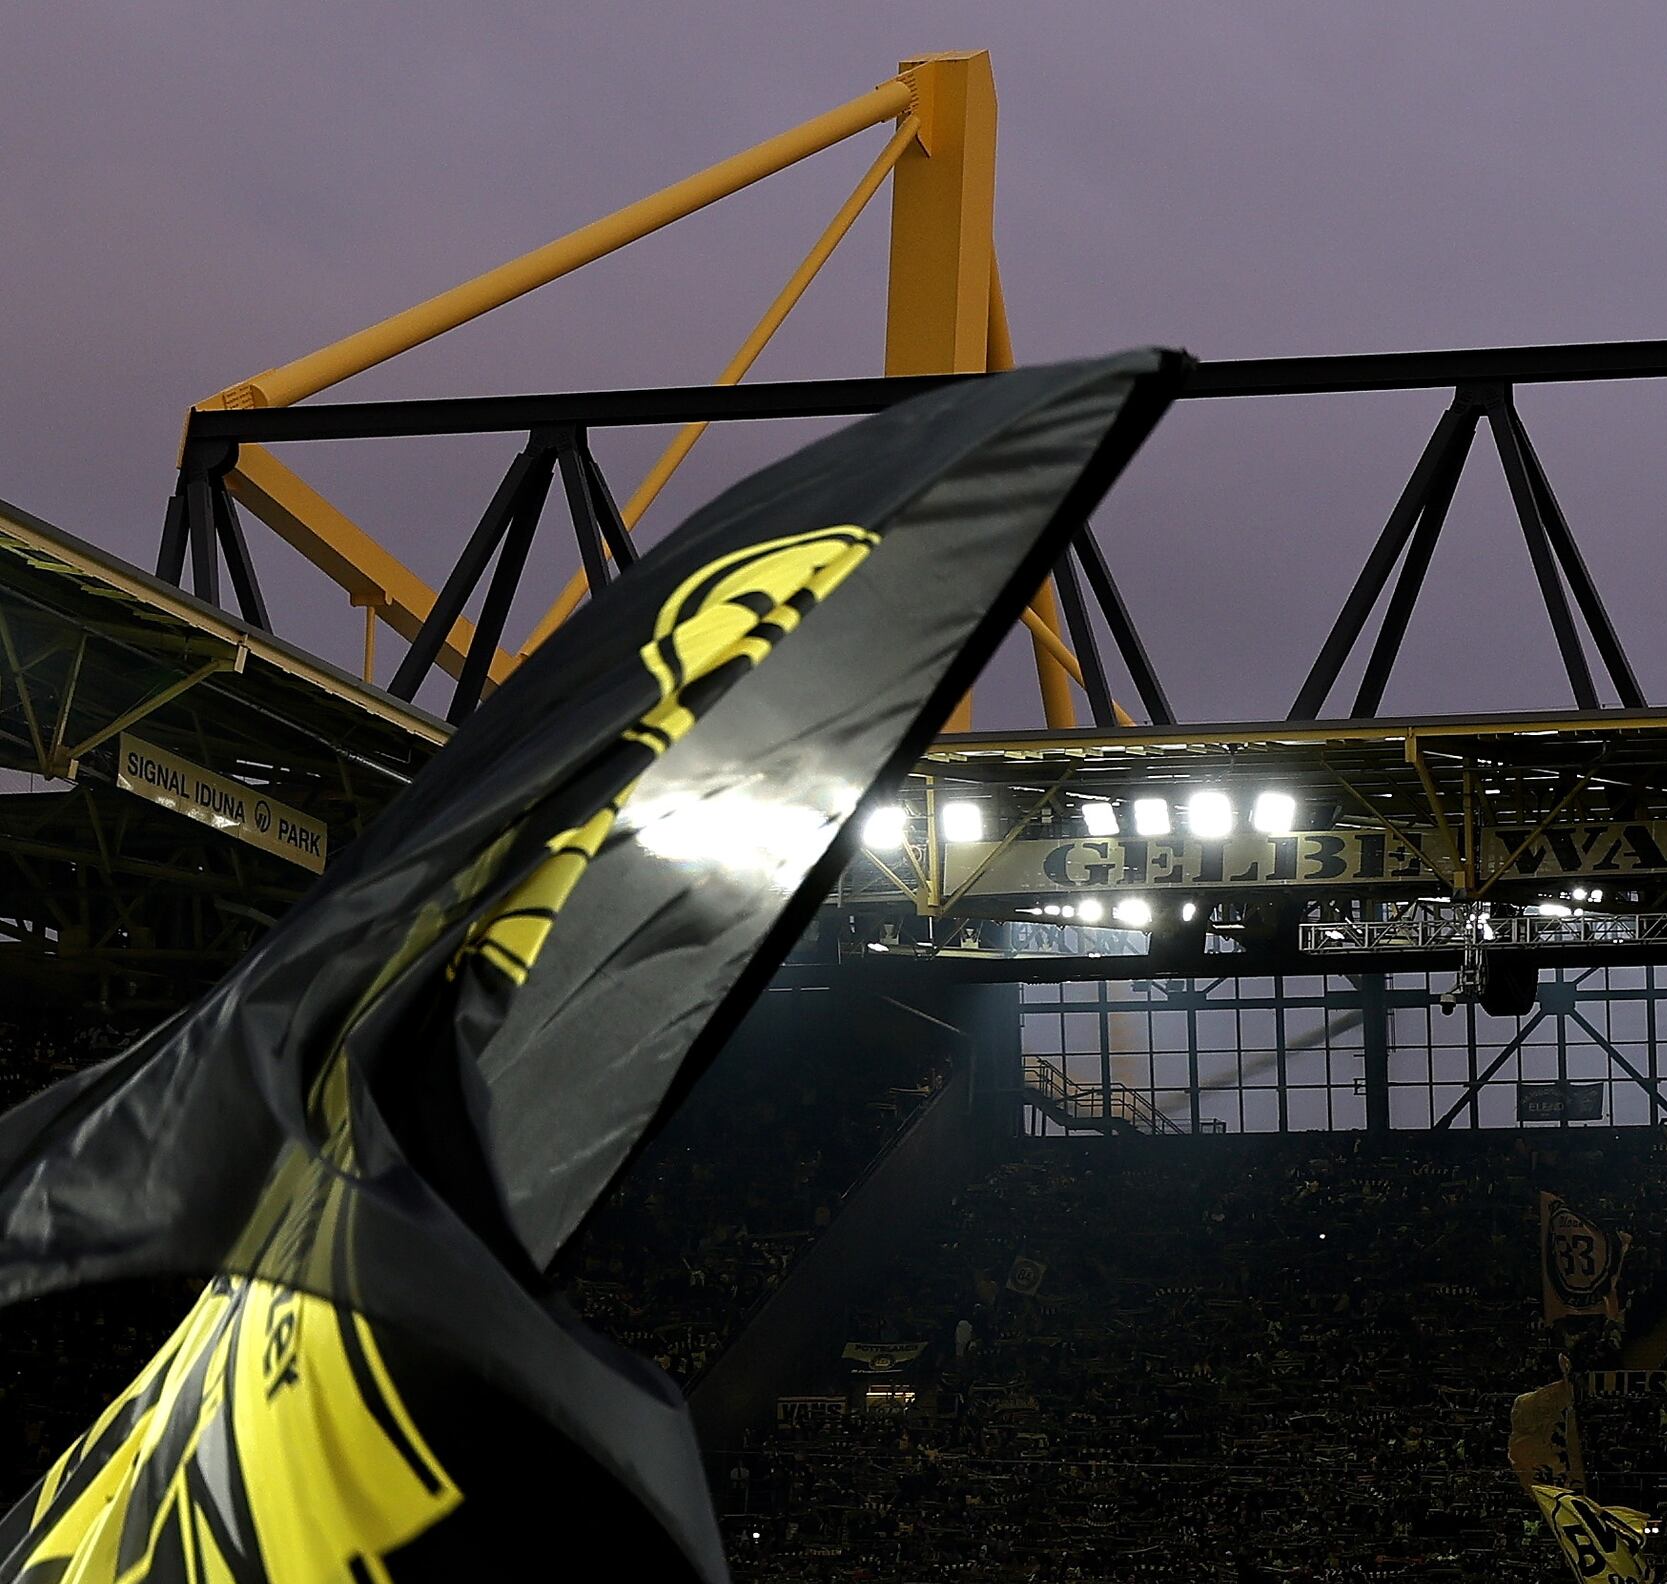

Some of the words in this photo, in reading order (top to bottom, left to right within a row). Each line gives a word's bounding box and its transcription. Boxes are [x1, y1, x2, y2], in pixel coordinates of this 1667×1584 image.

[127, 751, 190, 800] SIGNAL
[195, 780, 246, 824] IDUNA
[278, 818, 321, 858] PARK
[1043, 830, 1423, 888] GELBE
[1553, 1233, 1595, 1277] 33
